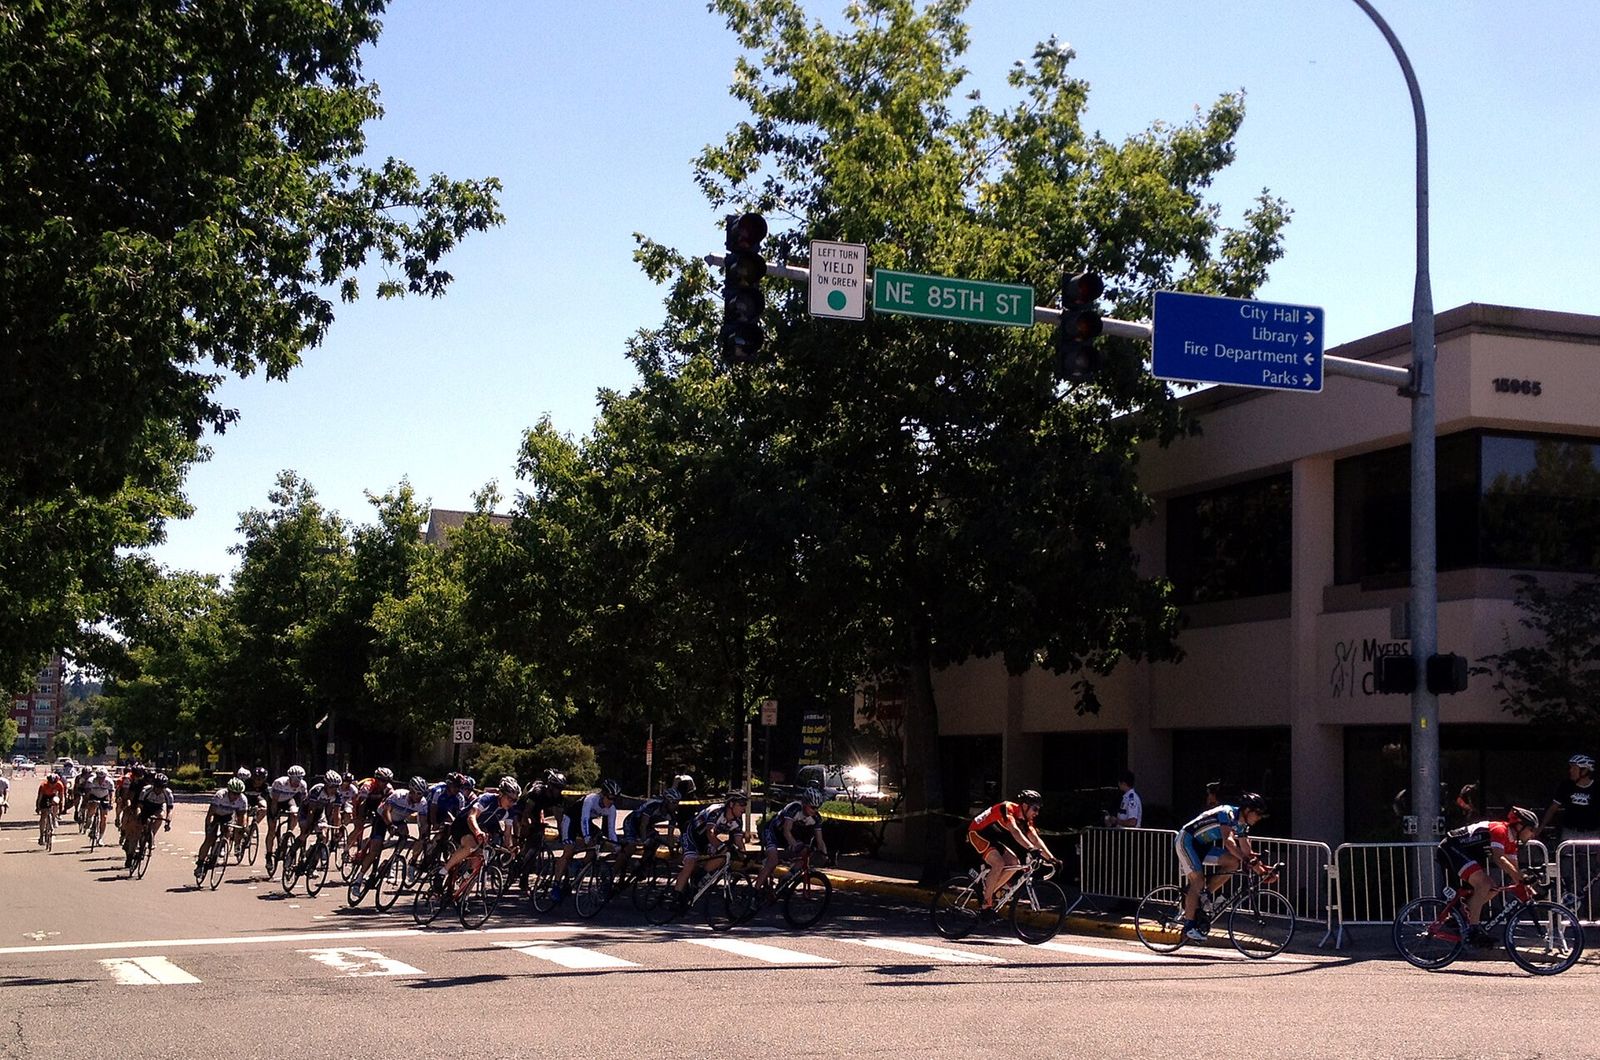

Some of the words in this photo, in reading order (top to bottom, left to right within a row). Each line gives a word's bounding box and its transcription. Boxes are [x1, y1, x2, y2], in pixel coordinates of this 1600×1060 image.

[817, 247, 836, 257] LEFT
[839, 249, 859, 260] TURN
[822, 260, 854, 275] YIELD
[817, 275, 829, 285] ON
[831, 276, 858, 288] GREEN
[885, 280, 915, 305] NE
[927, 287, 985, 313] 85TH
[995, 294, 1022, 316] ST
[1240, 304, 1269, 323] City
[1274, 307, 1300, 323] Hall
[1252, 326, 1299, 347] Library
[1184, 340, 1209, 356] Fire
[1214, 343, 1299, 365] Department
[1262, 369, 1299, 386] Parks
[455, 730, 472, 741] 30
